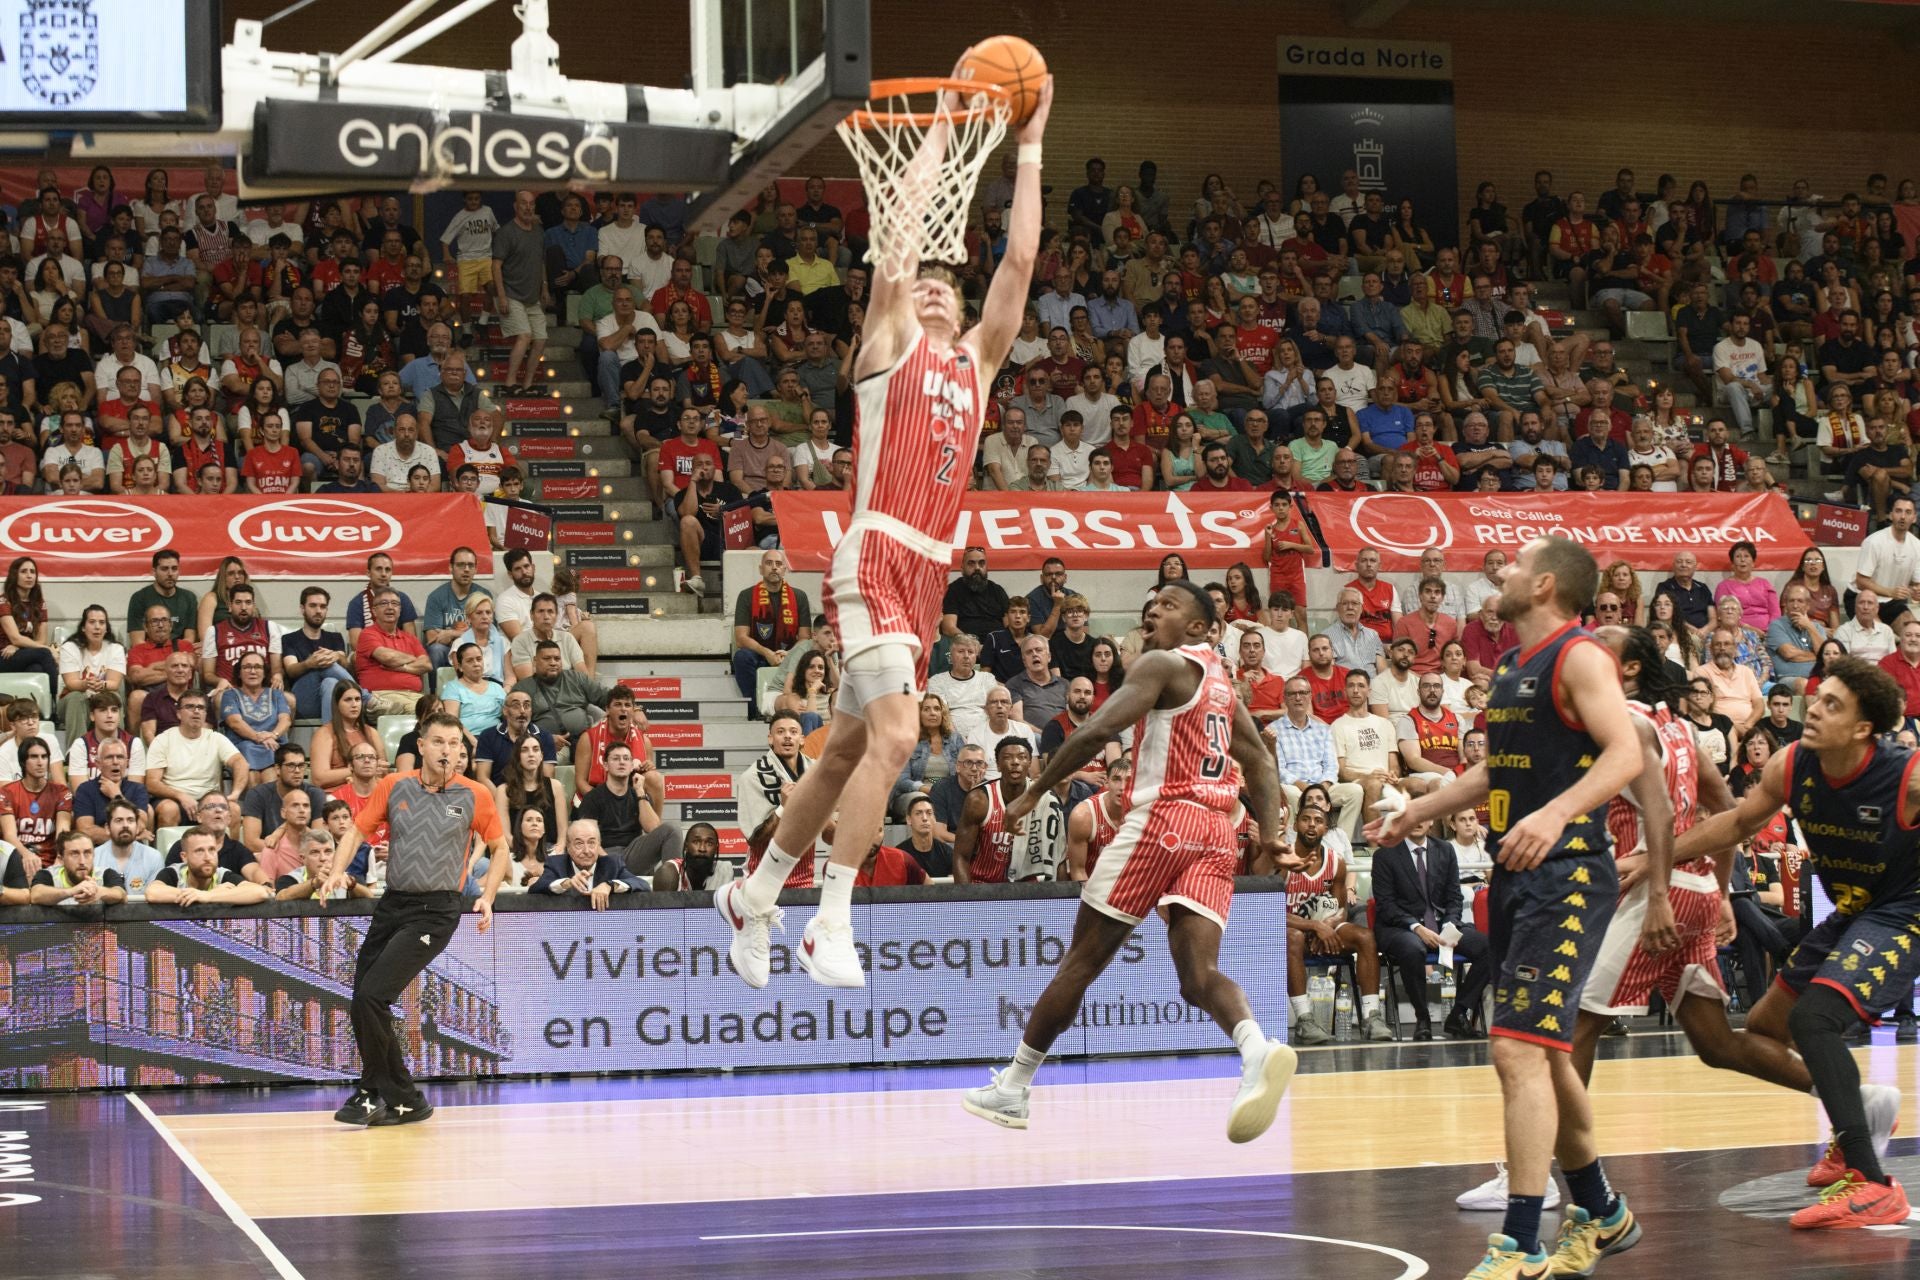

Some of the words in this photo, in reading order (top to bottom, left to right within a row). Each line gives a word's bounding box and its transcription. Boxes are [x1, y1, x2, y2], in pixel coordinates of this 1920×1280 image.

[1286, 44, 1366, 66] Grada
[1376, 47, 1444, 70] Norte
[338, 113, 619, 181] endesa
[935, 444, 962, 487] 2
[258, 476, 290, 488] UCAM
[1414, 470, 1445, 482] UCAM
[1469, 504, 1513, 520] Costa
[1515, 508, 1564, 522] Cálida
[18, 521, 151, 544] Juver
[251, 519, 380, 543] Juver
[512, 522, 545, 538] MÓDULO
[728, 520, 750, 535] MÓDULO
[1473, 523, 1599, 545] REGIÓN
[1601, 525, 1647, 543] DE
[1652, 525, 1778, 544] MURCIA
[1822, 518, 1860, 532] MÓDULO
[524, 537, 529, 545] 7
[1836, 531, 1843, 539] 8
[225, 645, 267, 660] UCAM
[1200, 712, 1232, 780] 31
[1420, 734, 1461, 750] UCAM
[17, 816, 56, 835] CAM
[1792, 886, 1801, 912] 2023
[541, 936, 812, 980] Viviena
[543, 1015, 612, 1048] en
[635, 999, 948, 1048] Guadalupe
